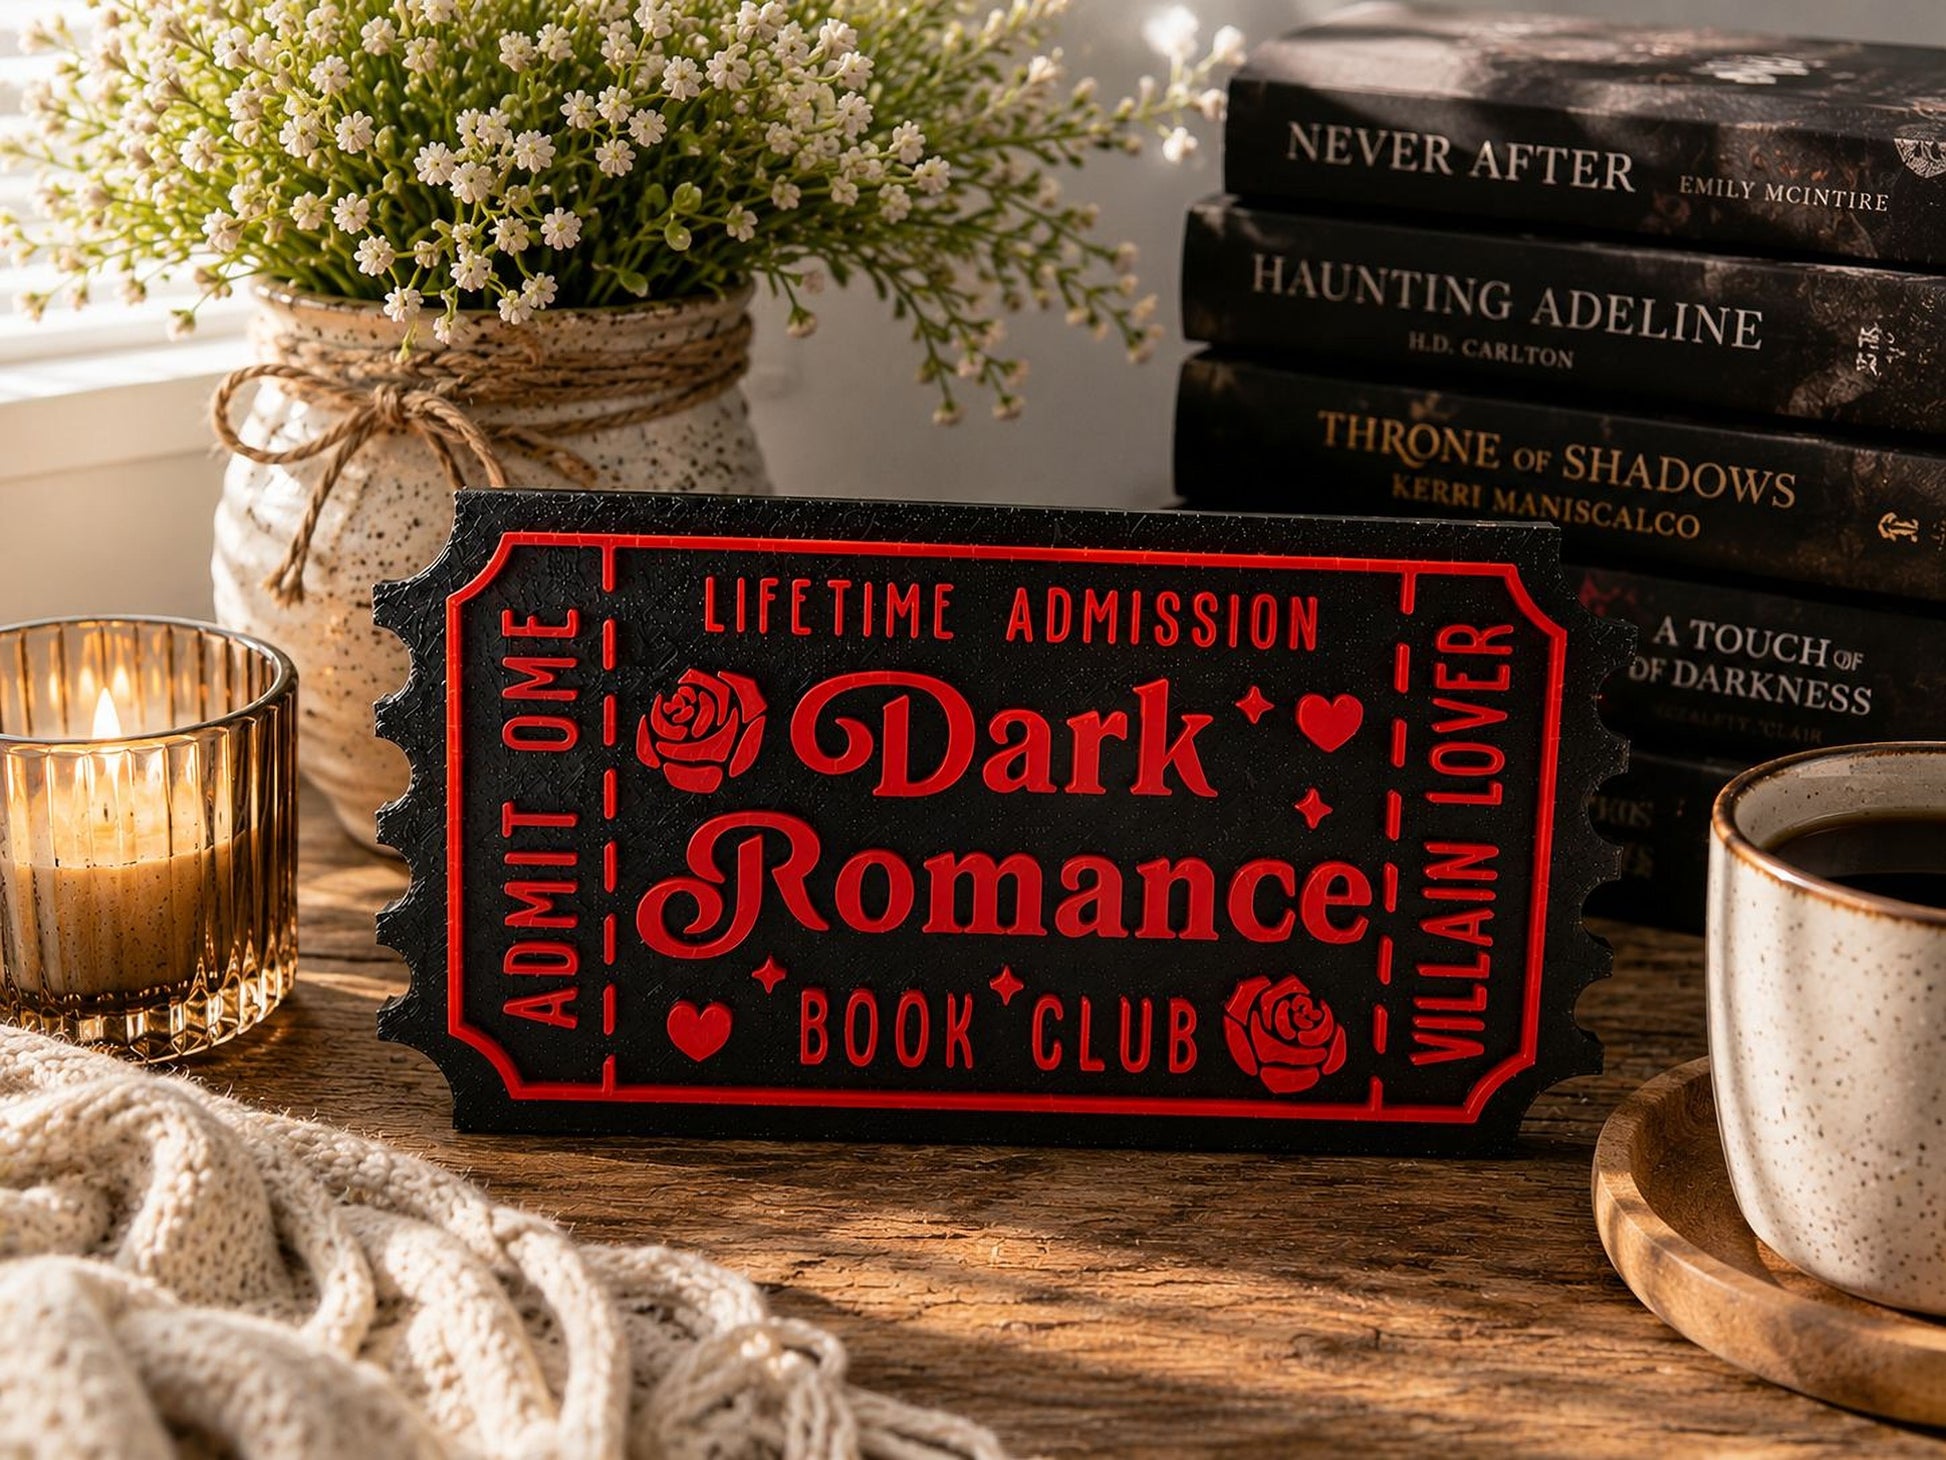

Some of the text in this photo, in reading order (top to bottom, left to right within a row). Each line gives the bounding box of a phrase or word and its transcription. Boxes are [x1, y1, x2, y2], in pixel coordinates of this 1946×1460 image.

[1286, 120, 1638, 194] NEVER AFTER
[1679, 174, 1890, 213] EMILY MCINTIRE
[1252, 252, 1764, 351] HAUNTING ADELINE
[1408, 330, 1575, 370] H.D. CARLTON
[1316, 408, 1796, 510] THRONE OF SHADOWS
[1391, 471, 1701, 540] KERRI MANISCALCO
[704, 575, 1318, 652] LIFETIME ADMISSION
[1652, 615, 1679, 647] A
[1689, 618, 1832, 669] TOUCH
[1628, 655, 1668, 684] OF
[1671, 658, 1873, 717] DARKNESS
[789, 670, 1218, 798] Dark
[501, 608, 580, 1029] ADMIT OME
[1410, 624, 1514, 1066] VILLAIN LOVER
[635, 810, 1373, 961] Romance
[800, 988, 1198, 1074] BOOK CLUB
